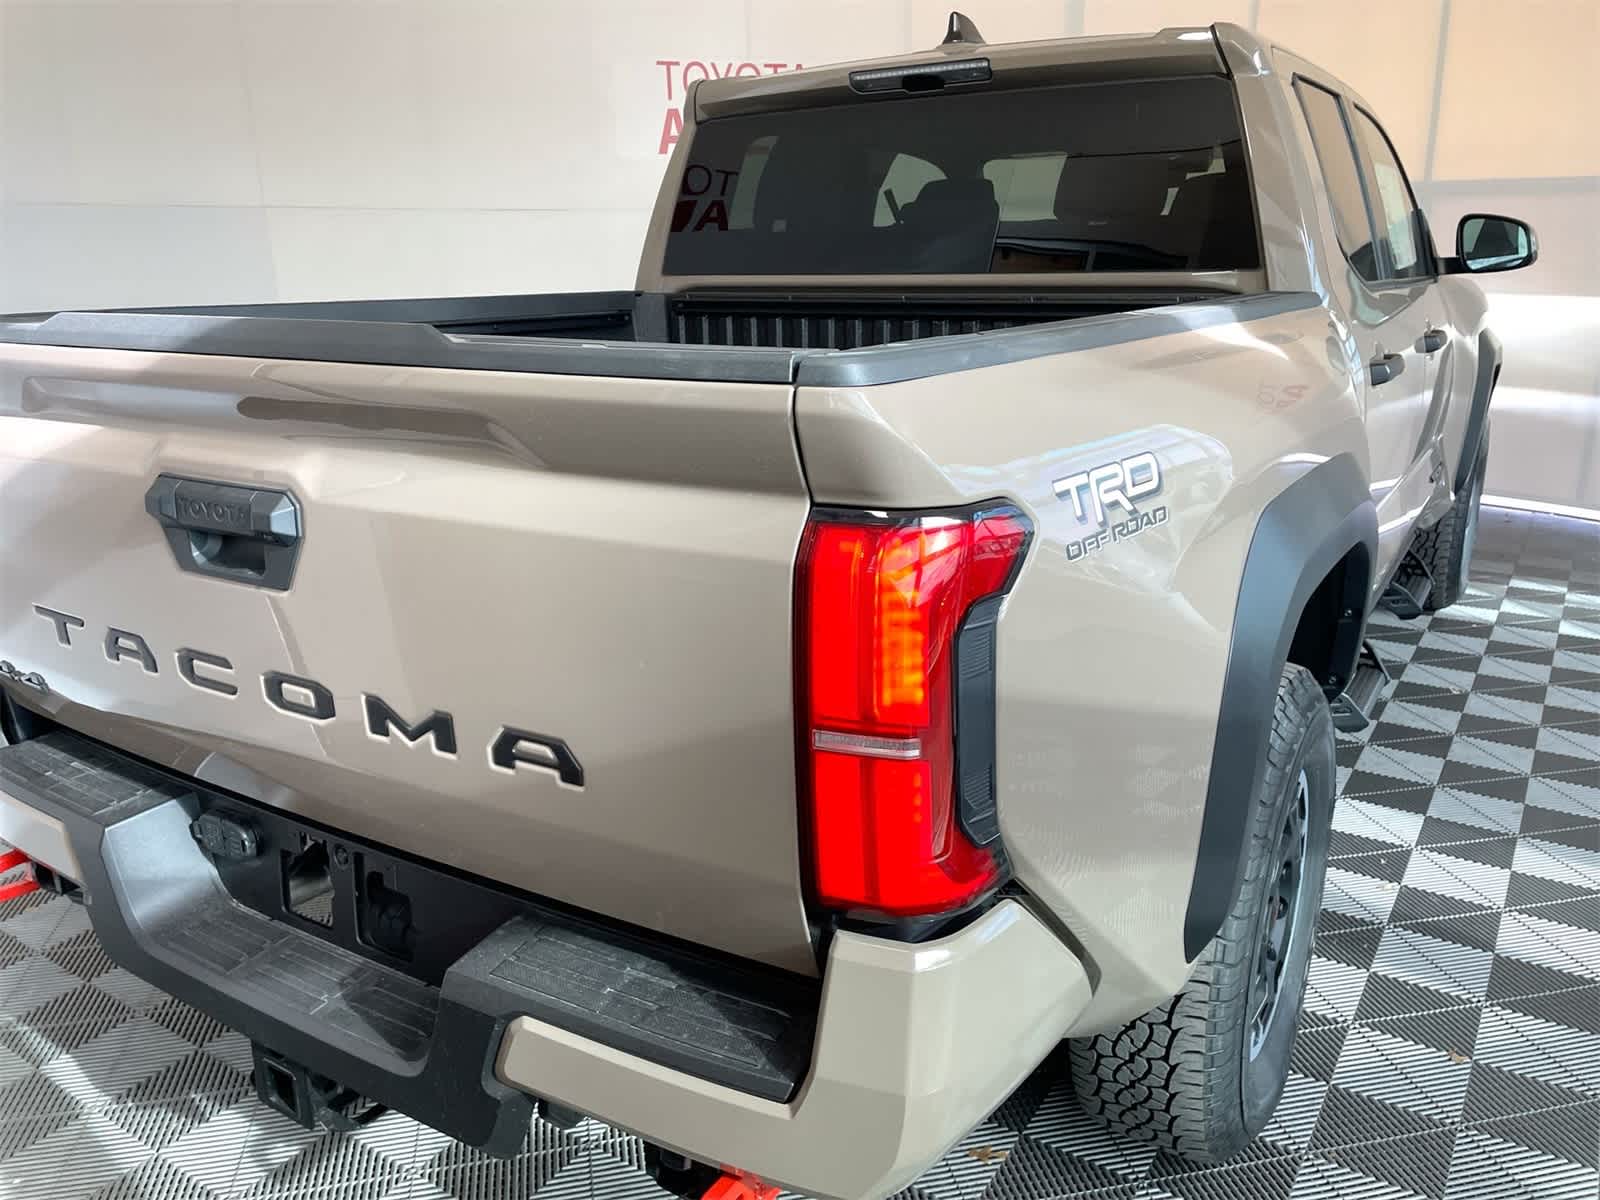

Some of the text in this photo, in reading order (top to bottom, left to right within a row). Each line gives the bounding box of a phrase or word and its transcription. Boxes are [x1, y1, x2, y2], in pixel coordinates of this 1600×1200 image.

[656, 60, 803, 101] TOYT
[177, 496, 249, 525] TOYOTA
[1052, 450, 1162, 526] TRD
[1066, 506, 1169, 561] OFF ROAD
[32, 601, 585, 792] TACOMA
